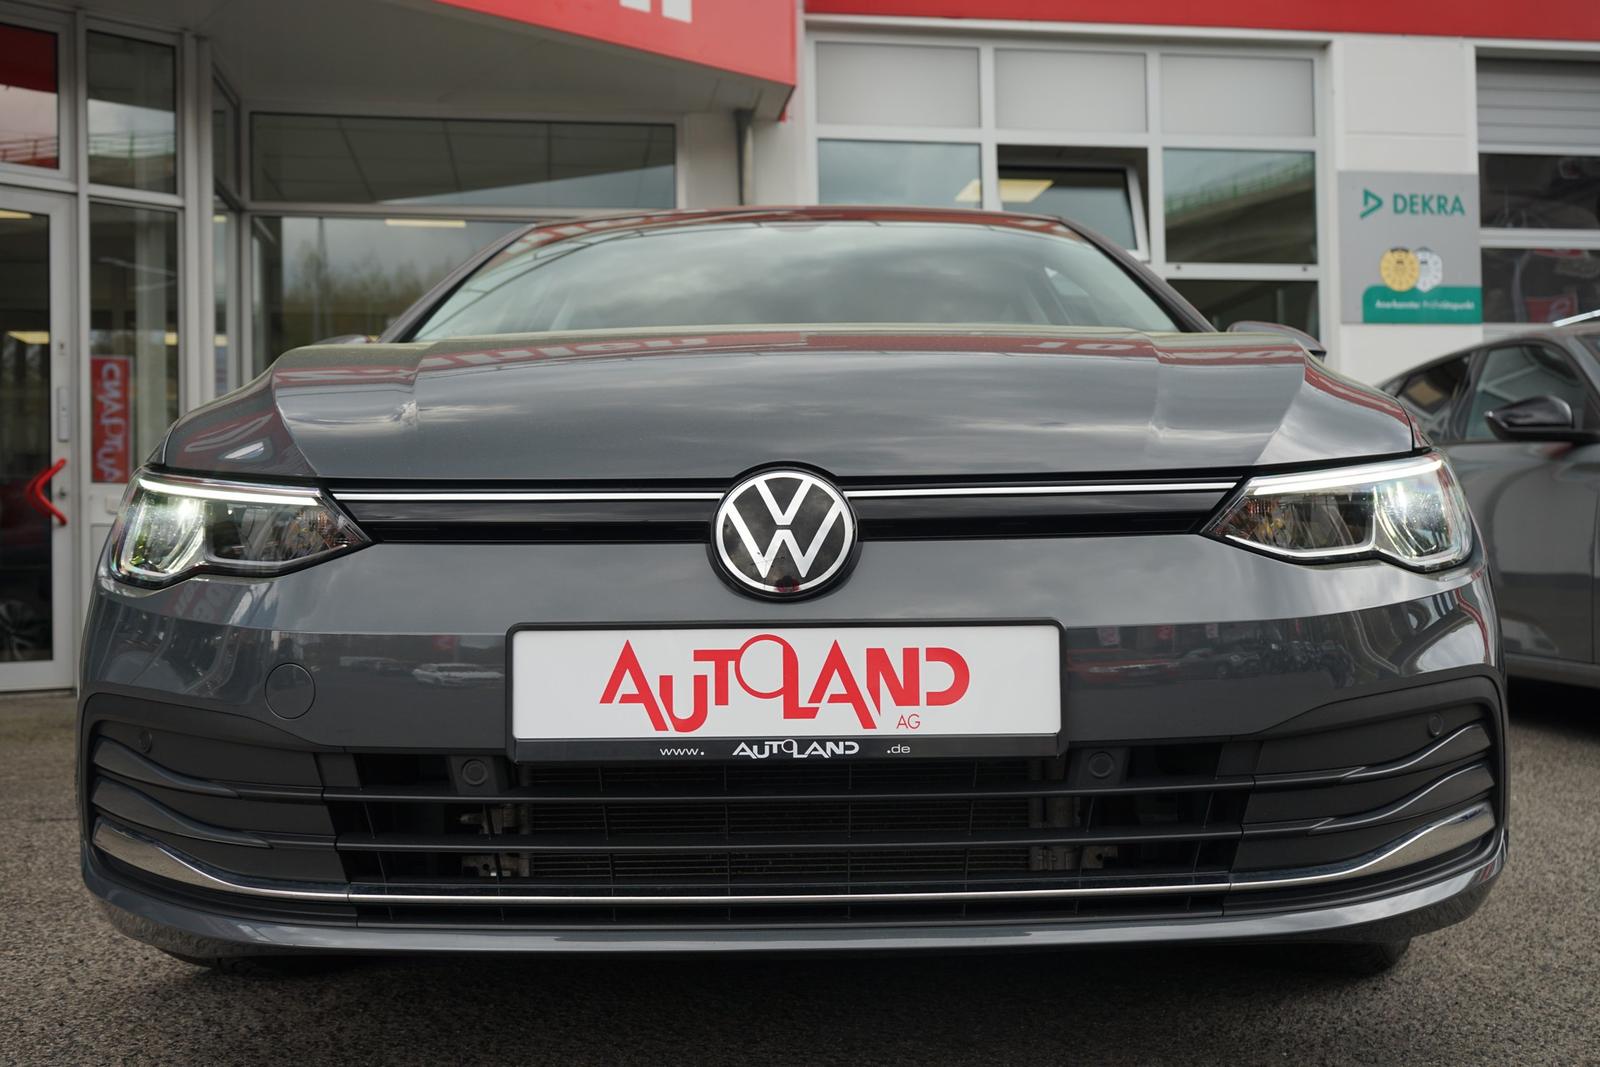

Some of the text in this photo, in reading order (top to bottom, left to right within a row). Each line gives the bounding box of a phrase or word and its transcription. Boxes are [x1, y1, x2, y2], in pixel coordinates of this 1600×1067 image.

[1392, 193, 1465, 215] DEKRA
[600, 634, 970, 733] AUTOLAND
[896, 713, 922, 731] AG
[659, 739, 911, 760] www. AUTOLAND .de
